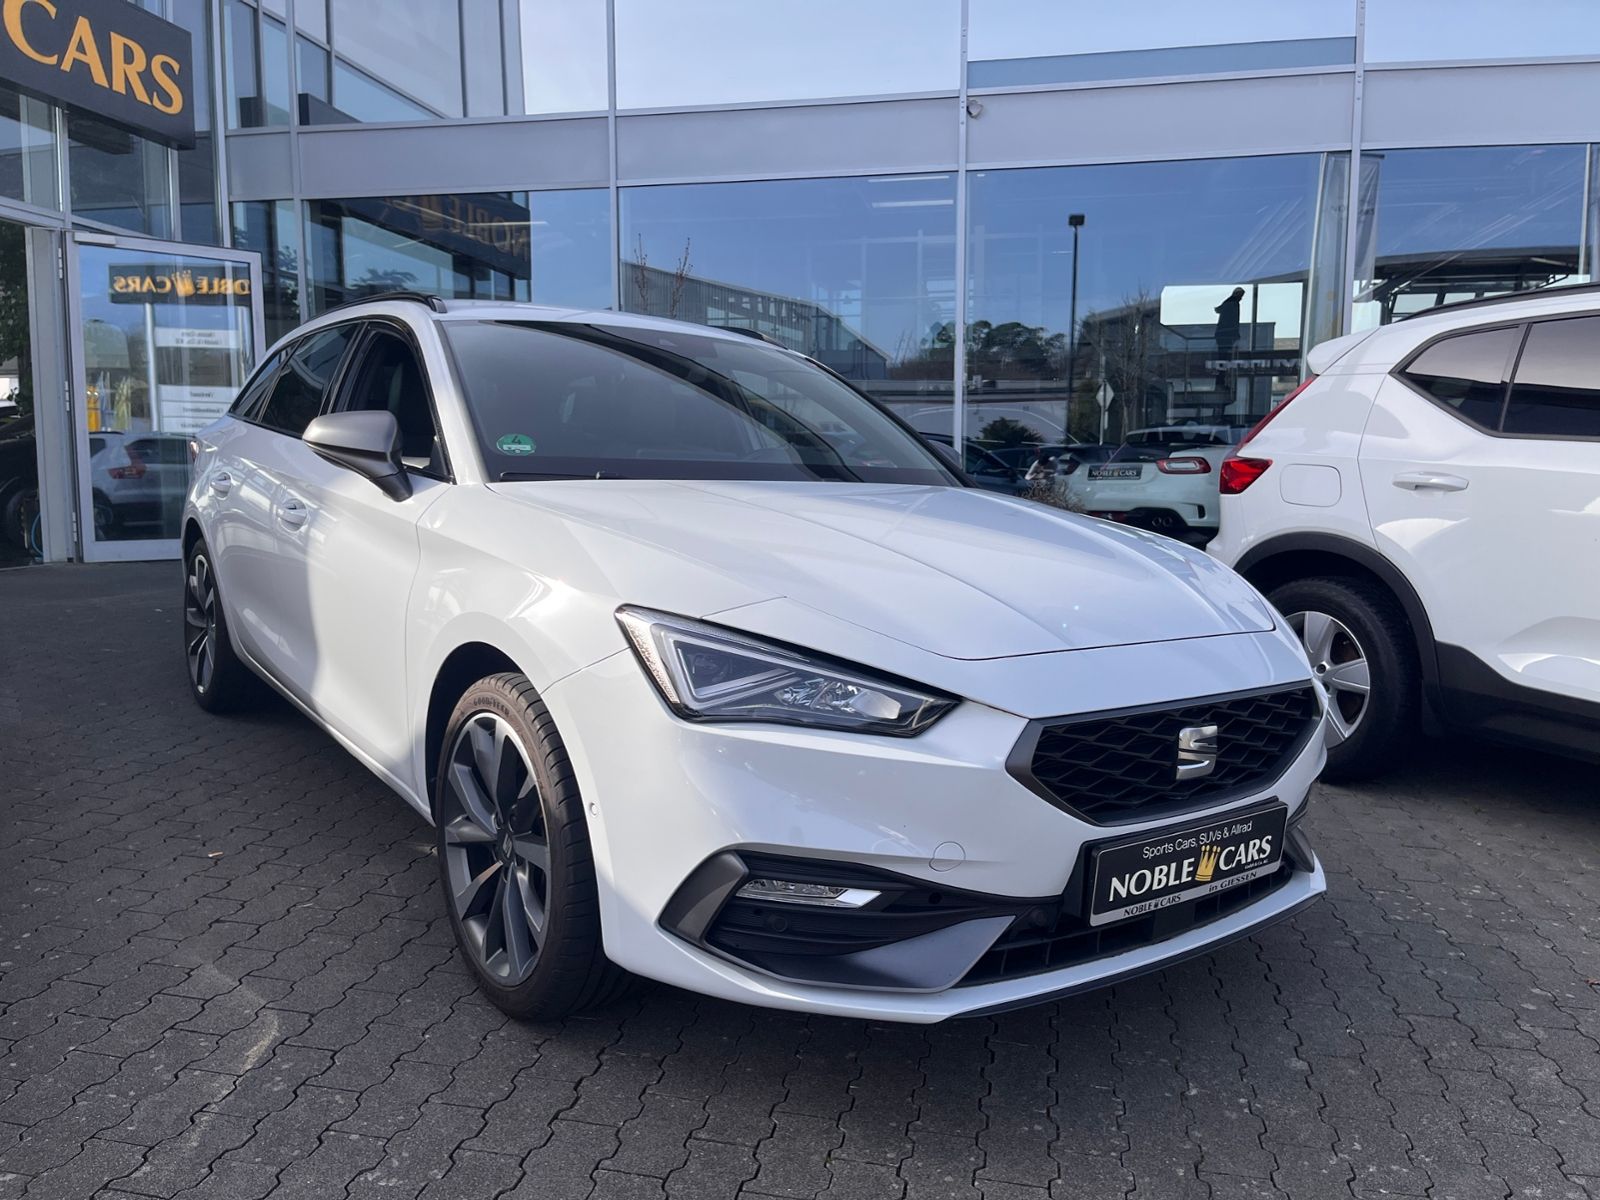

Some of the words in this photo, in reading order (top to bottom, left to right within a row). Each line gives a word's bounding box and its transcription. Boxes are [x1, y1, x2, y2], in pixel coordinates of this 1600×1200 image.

[3, 0, 184, 115] CARS
[511, 435, 522, 445] 4
[1119, 469, 1137, 477] CARS
[1142, 842, 1174, 859] Sports
[1199, 829, 1222, 845] SUVs
[1222, 827, 1229, 838] &
[1230, 821, 1253, 837] Allrad
[1108, 857, 1196, 902] NOBLE
[1218, 835, 1273, 871] CARS
[1208, 884, 1219, 893] in
[1220, 871, 1258, 890] GIESSEN
[1123, 901, 1153, 917] NOBLE
[1160, 894, 1182, 907] CARS
